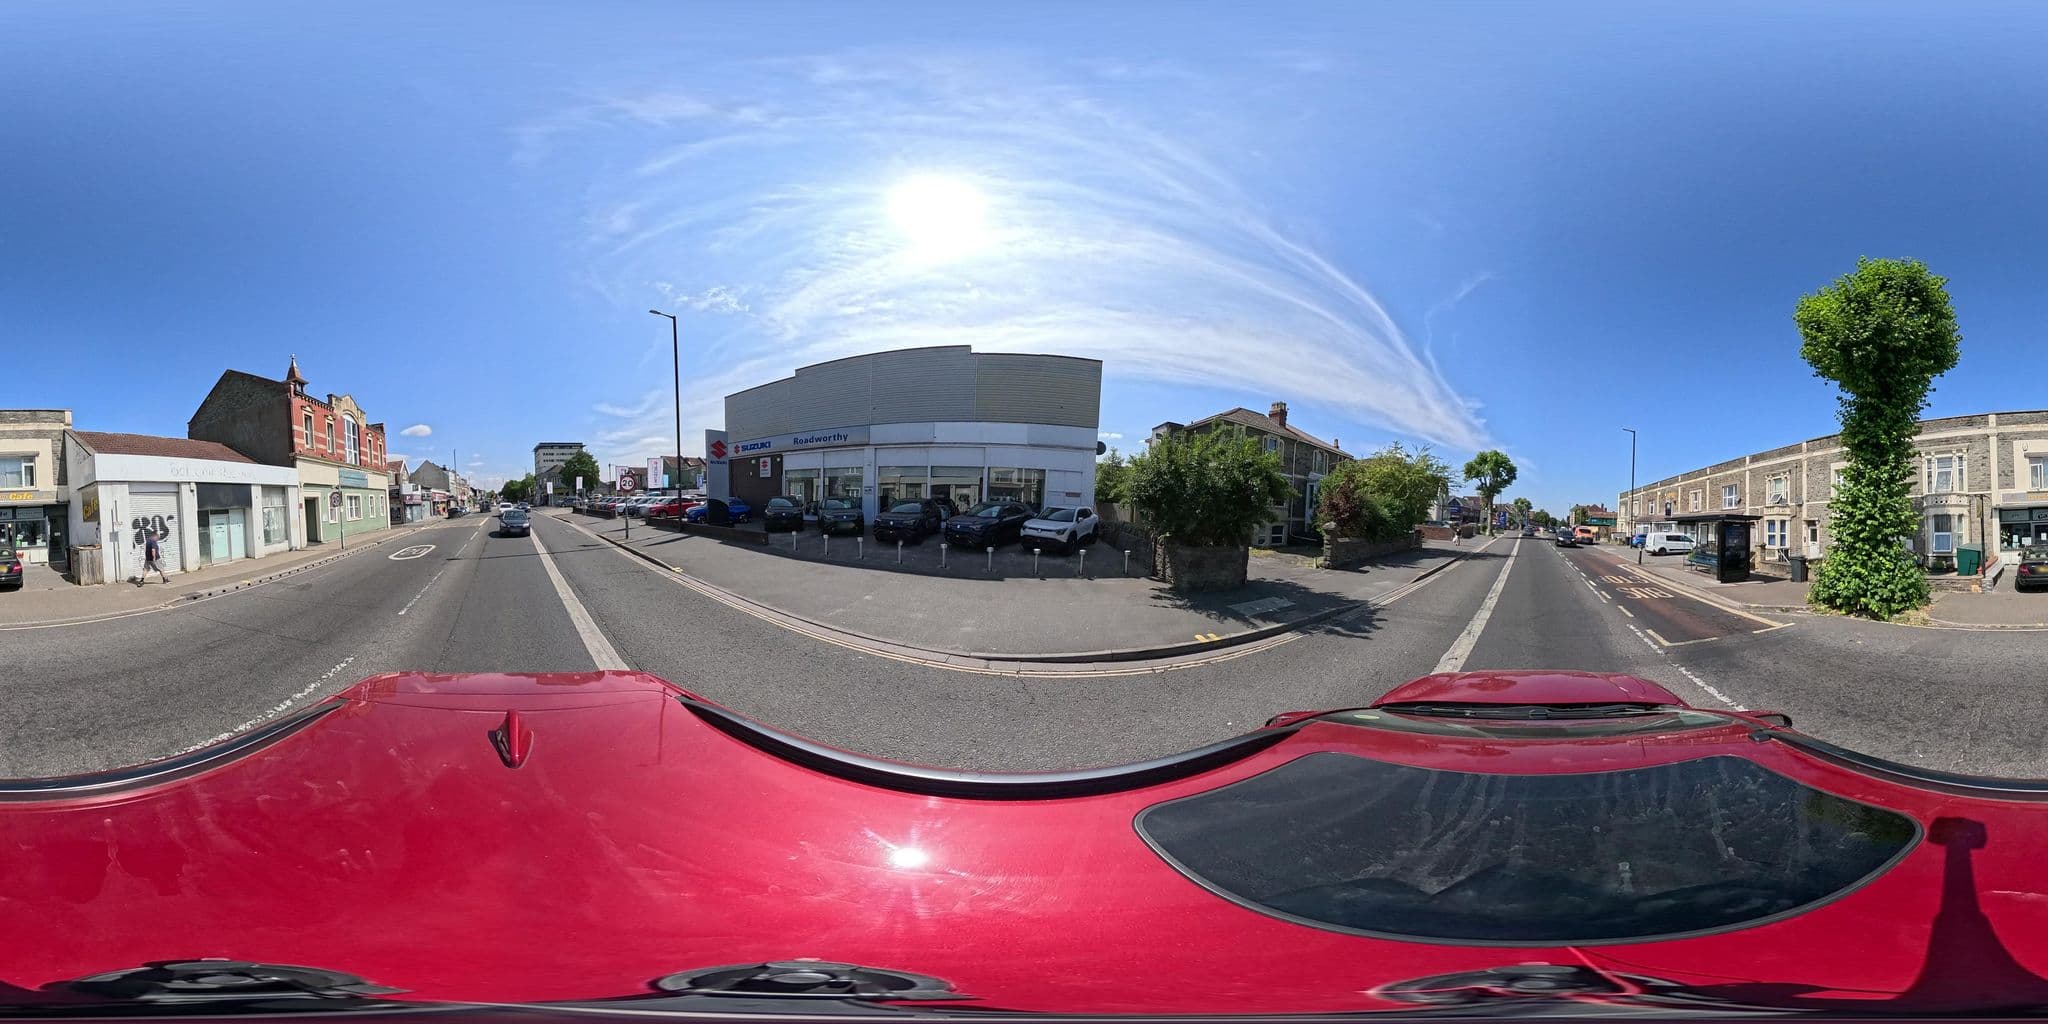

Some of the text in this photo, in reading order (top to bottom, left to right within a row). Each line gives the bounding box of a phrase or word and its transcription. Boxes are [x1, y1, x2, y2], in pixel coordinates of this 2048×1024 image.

[793, 433, 848, 445] Roadworthy
[741, 441, 771, 452] SUZUKI
[622, 479, 633, 487] 20
[1616, 587, 1675, 599] BUS
